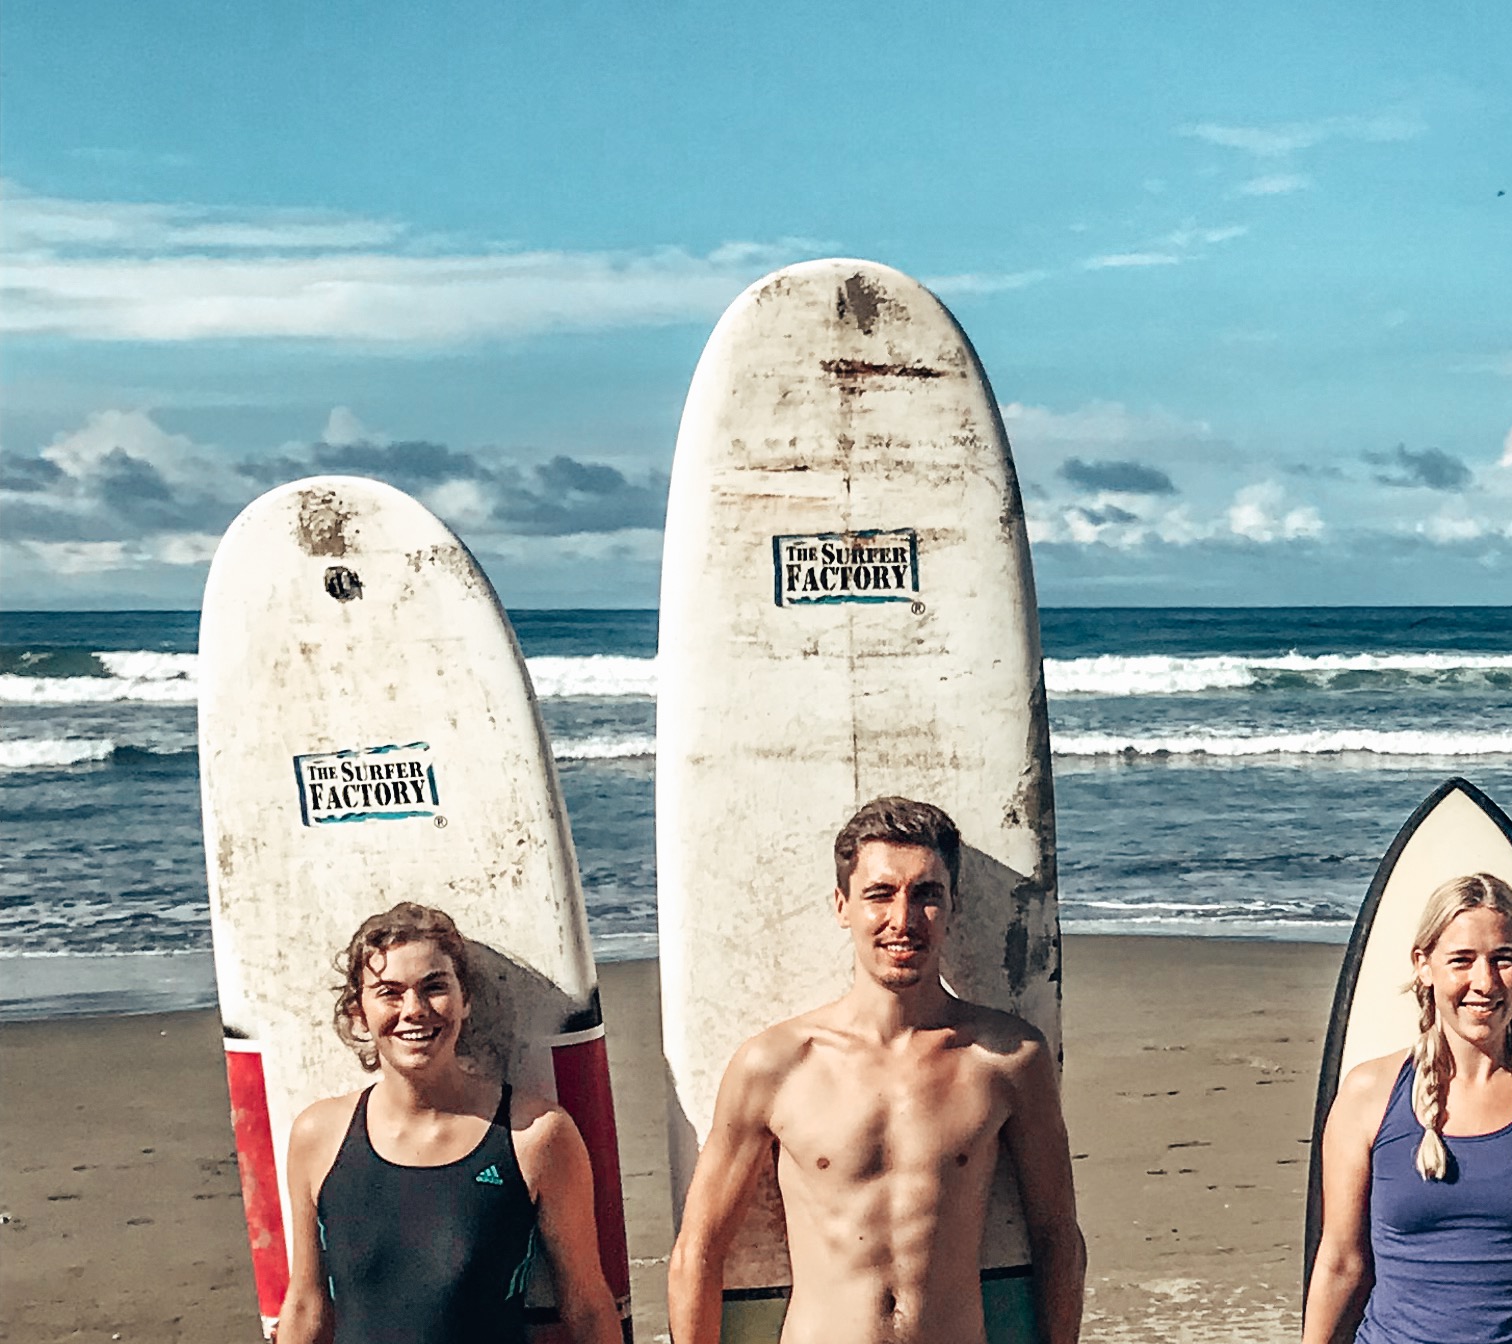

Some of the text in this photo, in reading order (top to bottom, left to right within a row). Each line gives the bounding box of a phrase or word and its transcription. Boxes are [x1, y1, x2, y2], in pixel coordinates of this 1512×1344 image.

[786, 543, 907, 564] THE SURFER
[786, 564, 908, 592] FACTORY
[307, 761, 424, 782] THE SURFER
[309, 779, 425, 810] FACTORY
